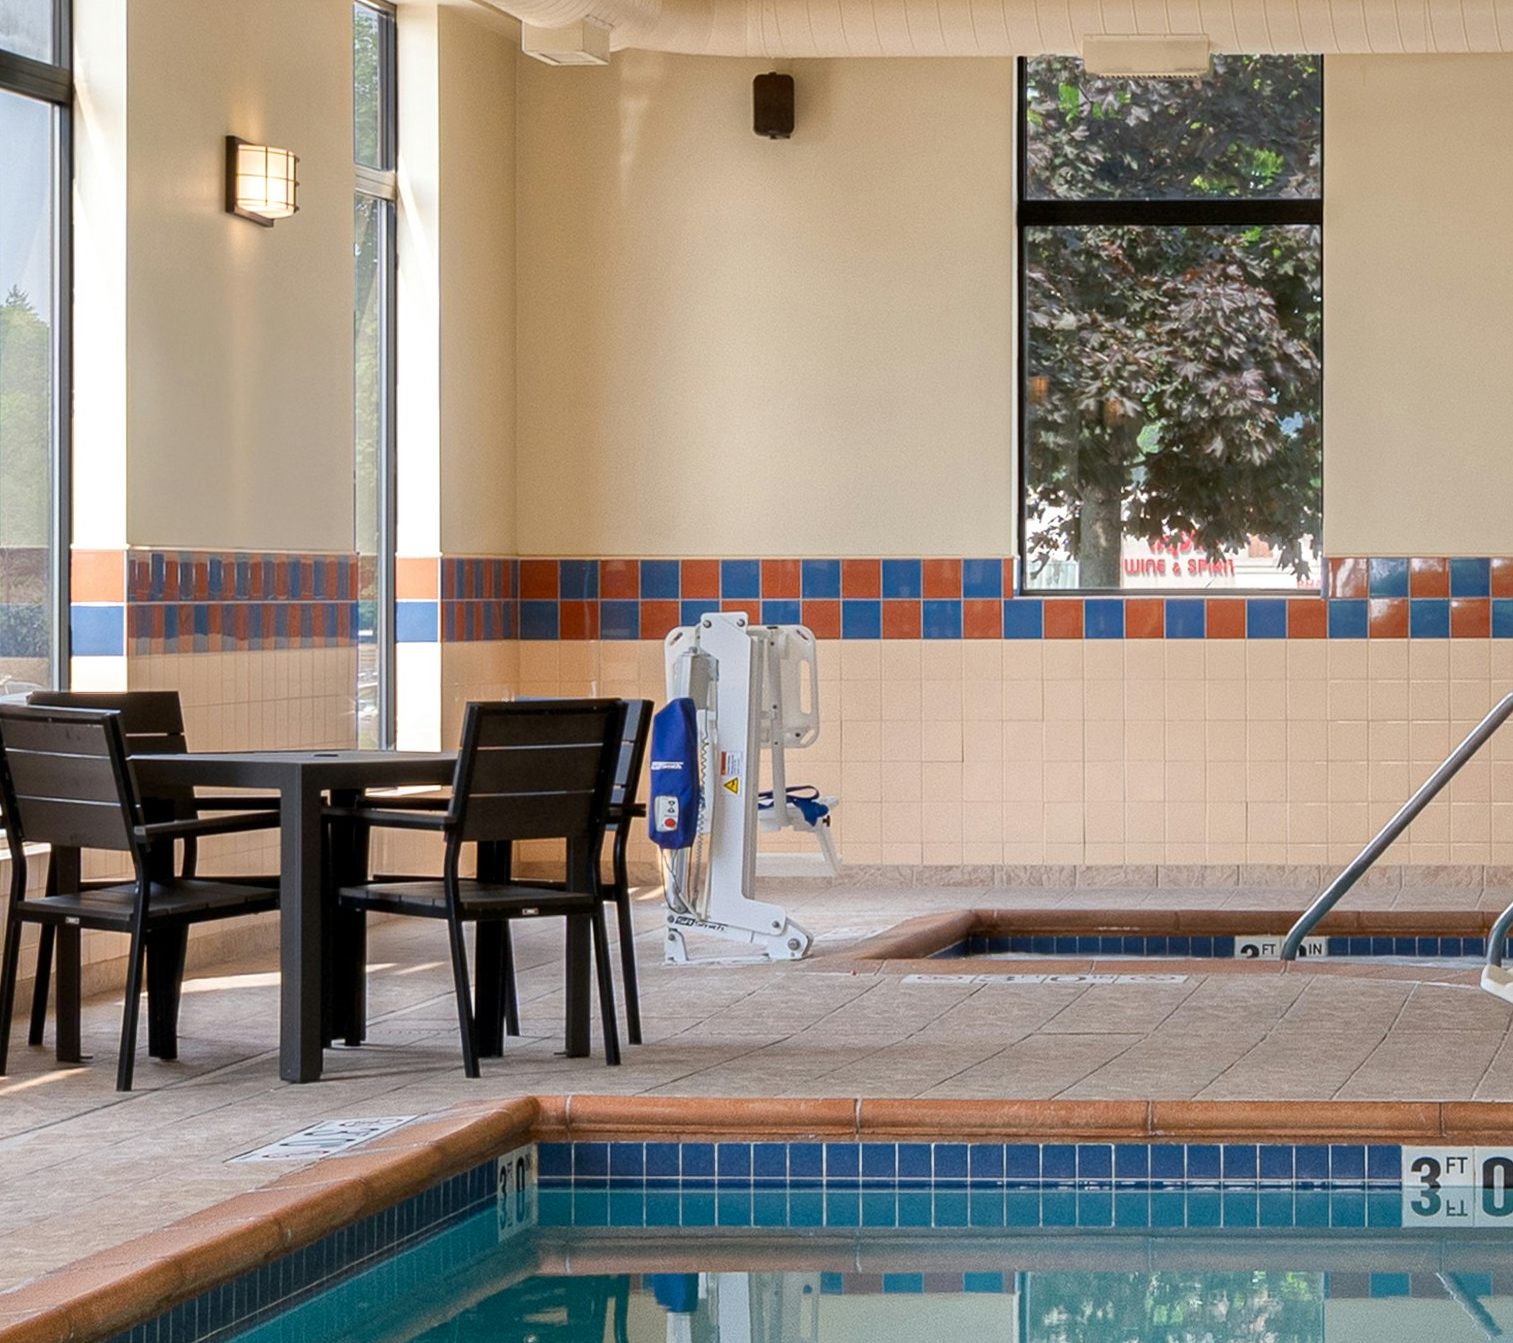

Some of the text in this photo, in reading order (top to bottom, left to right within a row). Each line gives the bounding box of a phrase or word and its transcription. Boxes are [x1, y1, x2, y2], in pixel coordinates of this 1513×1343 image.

[1125, 559, 1166, 574] WINE
[1172, 562, 1181, 574] &
[1262, 944, 1276, 955] FT
[1308, 943, 1322, 955] IN
[1446, 1157, 1468, 1174] FT
